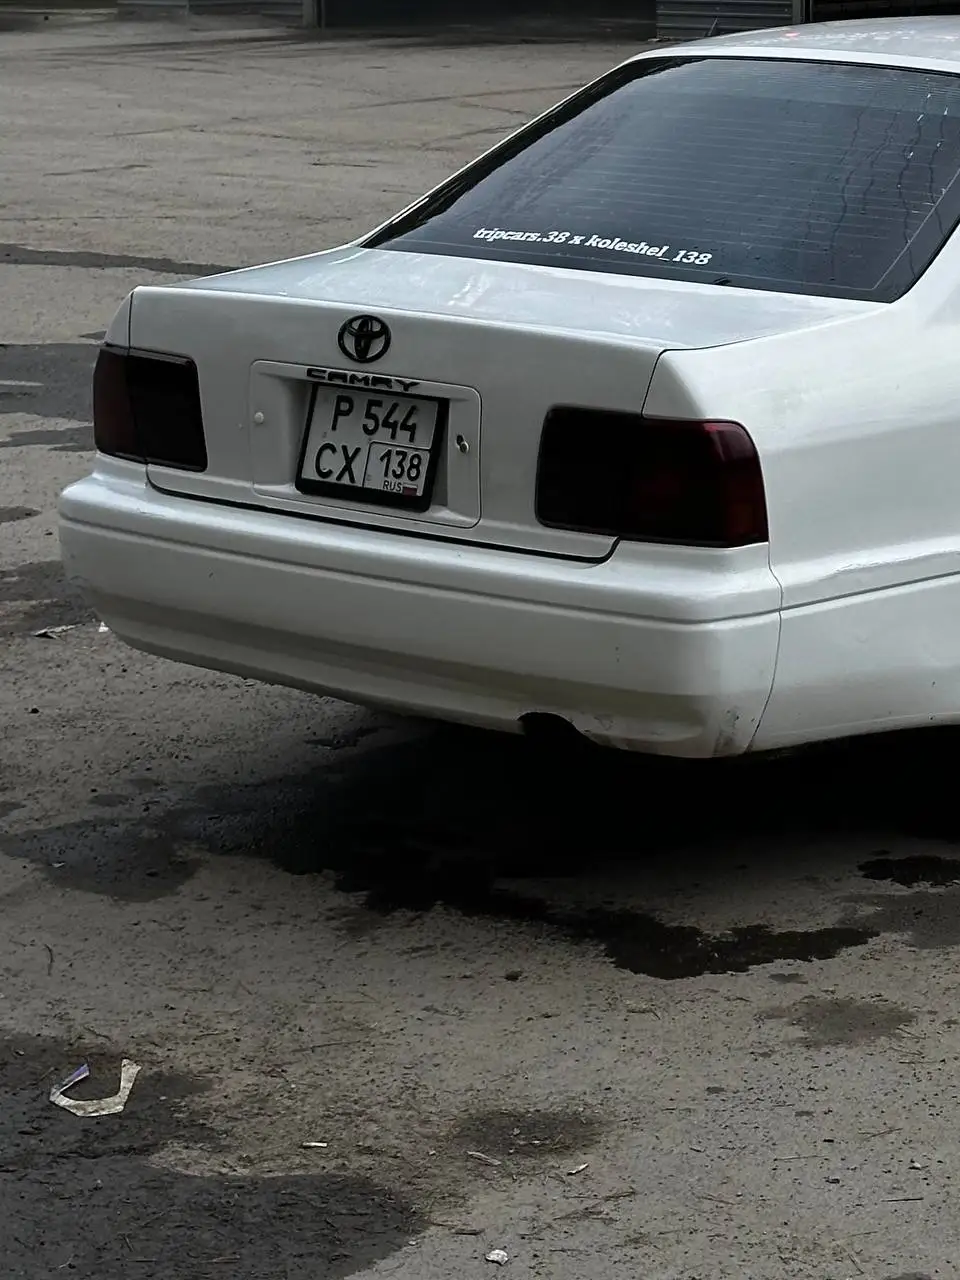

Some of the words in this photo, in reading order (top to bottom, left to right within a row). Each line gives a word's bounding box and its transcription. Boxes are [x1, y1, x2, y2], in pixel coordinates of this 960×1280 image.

[473, 227, 571, 246] tripcars.38
[306, 367, 421, 391] CAMRY
[331, 394, 354, 431] Р
[362, 399, 417, 443] 544
[314, 442, 362, 484] СХ
[379, 448, 422, 482] 138
[382, 479, 403, 491] RUS
